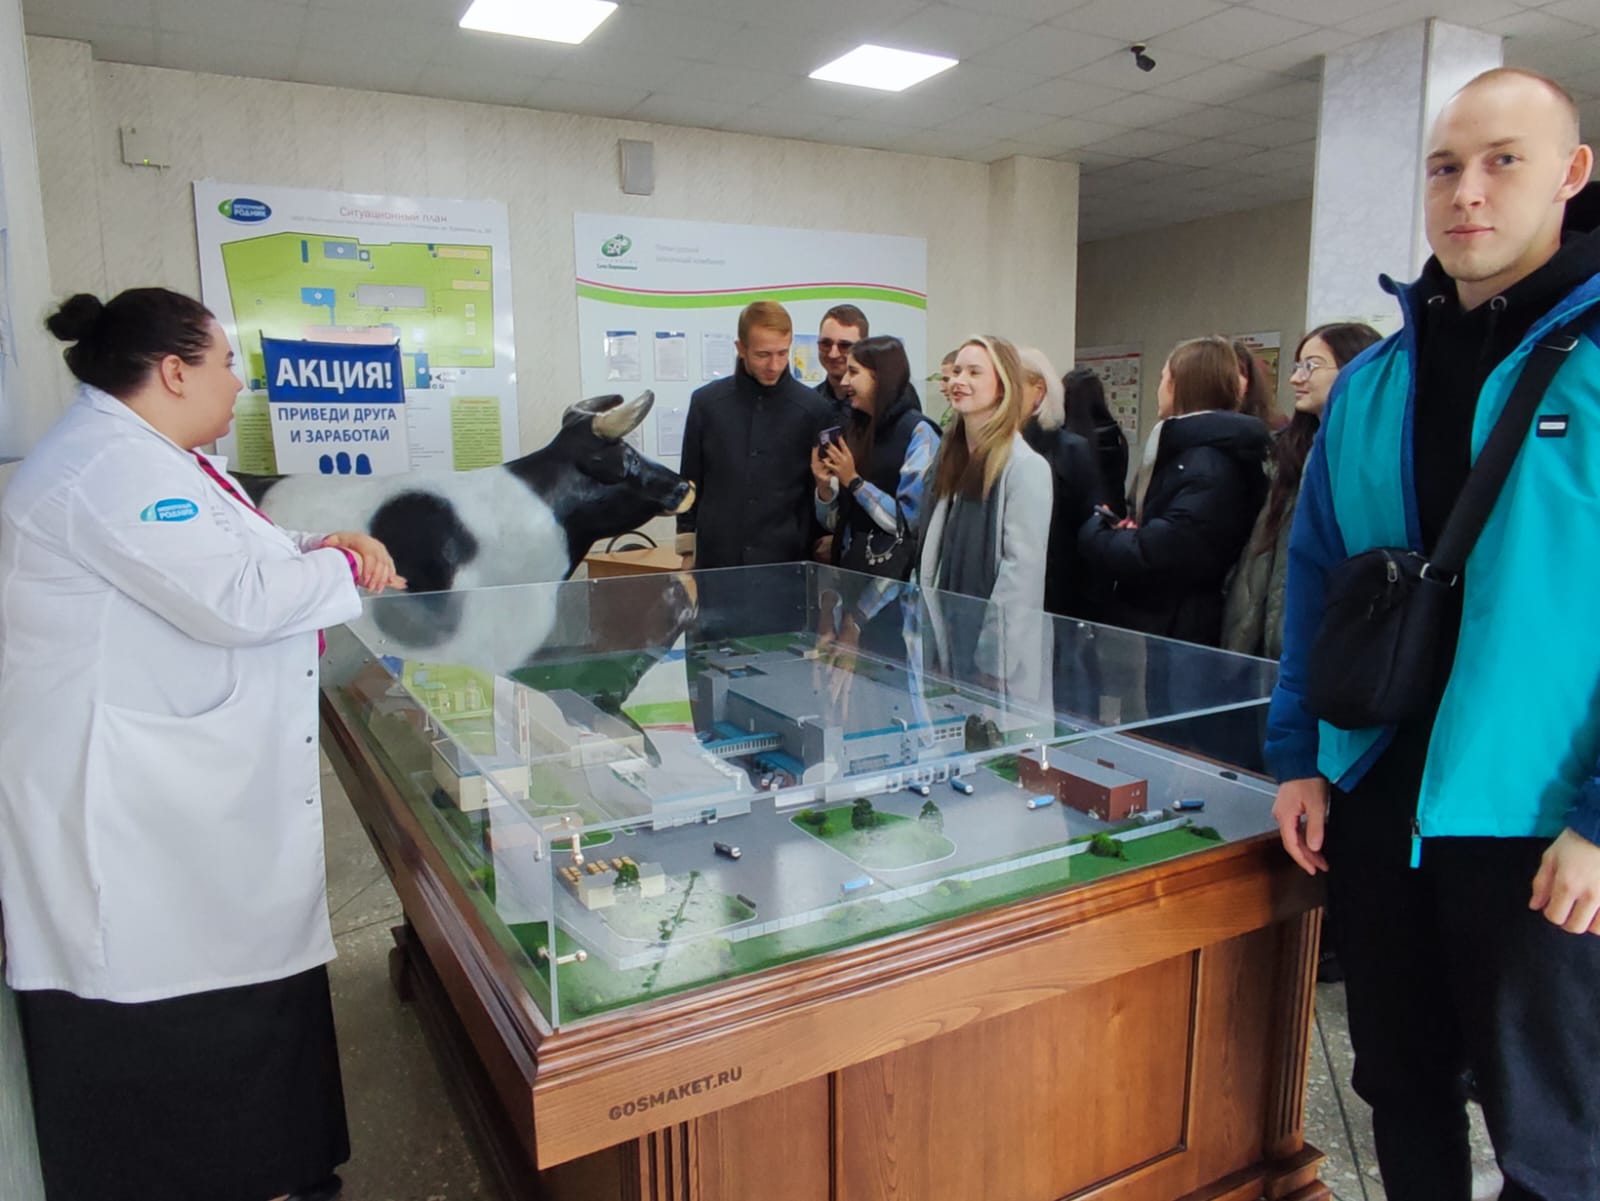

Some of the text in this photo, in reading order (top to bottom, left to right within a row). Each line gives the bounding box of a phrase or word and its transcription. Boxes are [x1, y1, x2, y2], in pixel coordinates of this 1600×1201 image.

[422, 214, 448, 223] план
[275, 358, 393, 395] АКЦИЯ!
[278, 407, 397, 424] ПРИВЕДИ ДРУГА
[290, 426, 390, 442] И ЗАРАБОТАЙ
[608, 1066, 742, 1121] GOSMAKET.RU
